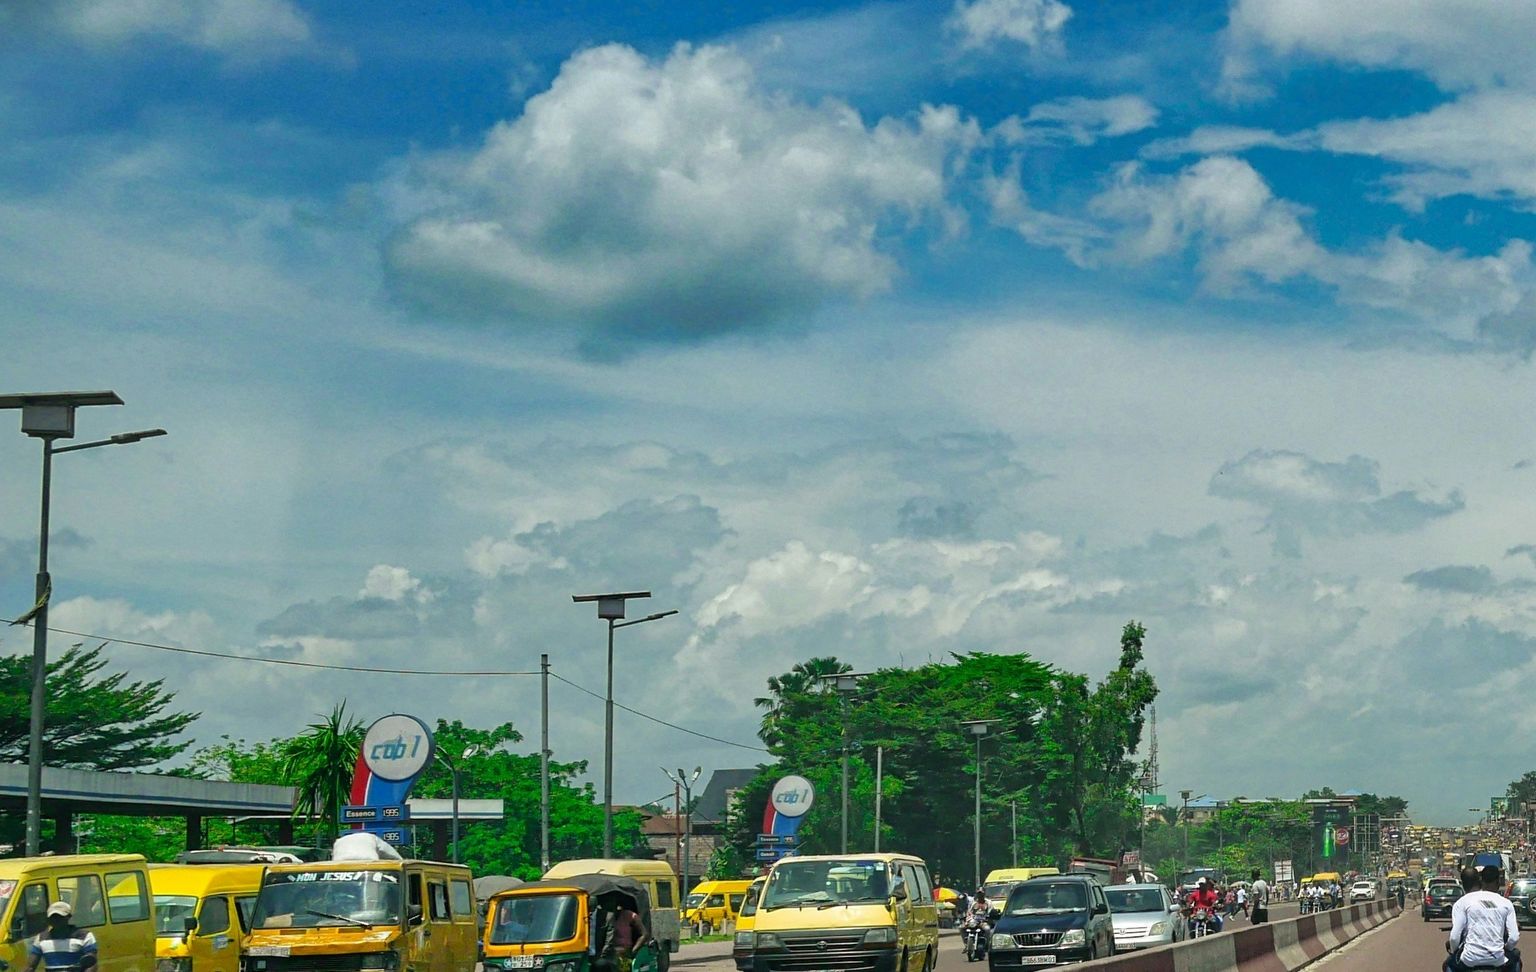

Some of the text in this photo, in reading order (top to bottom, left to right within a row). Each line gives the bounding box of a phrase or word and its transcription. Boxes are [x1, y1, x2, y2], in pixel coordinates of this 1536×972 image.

[346, 810, 375, 818] Essence
[297, 872, 353, 882] MON JESUS
